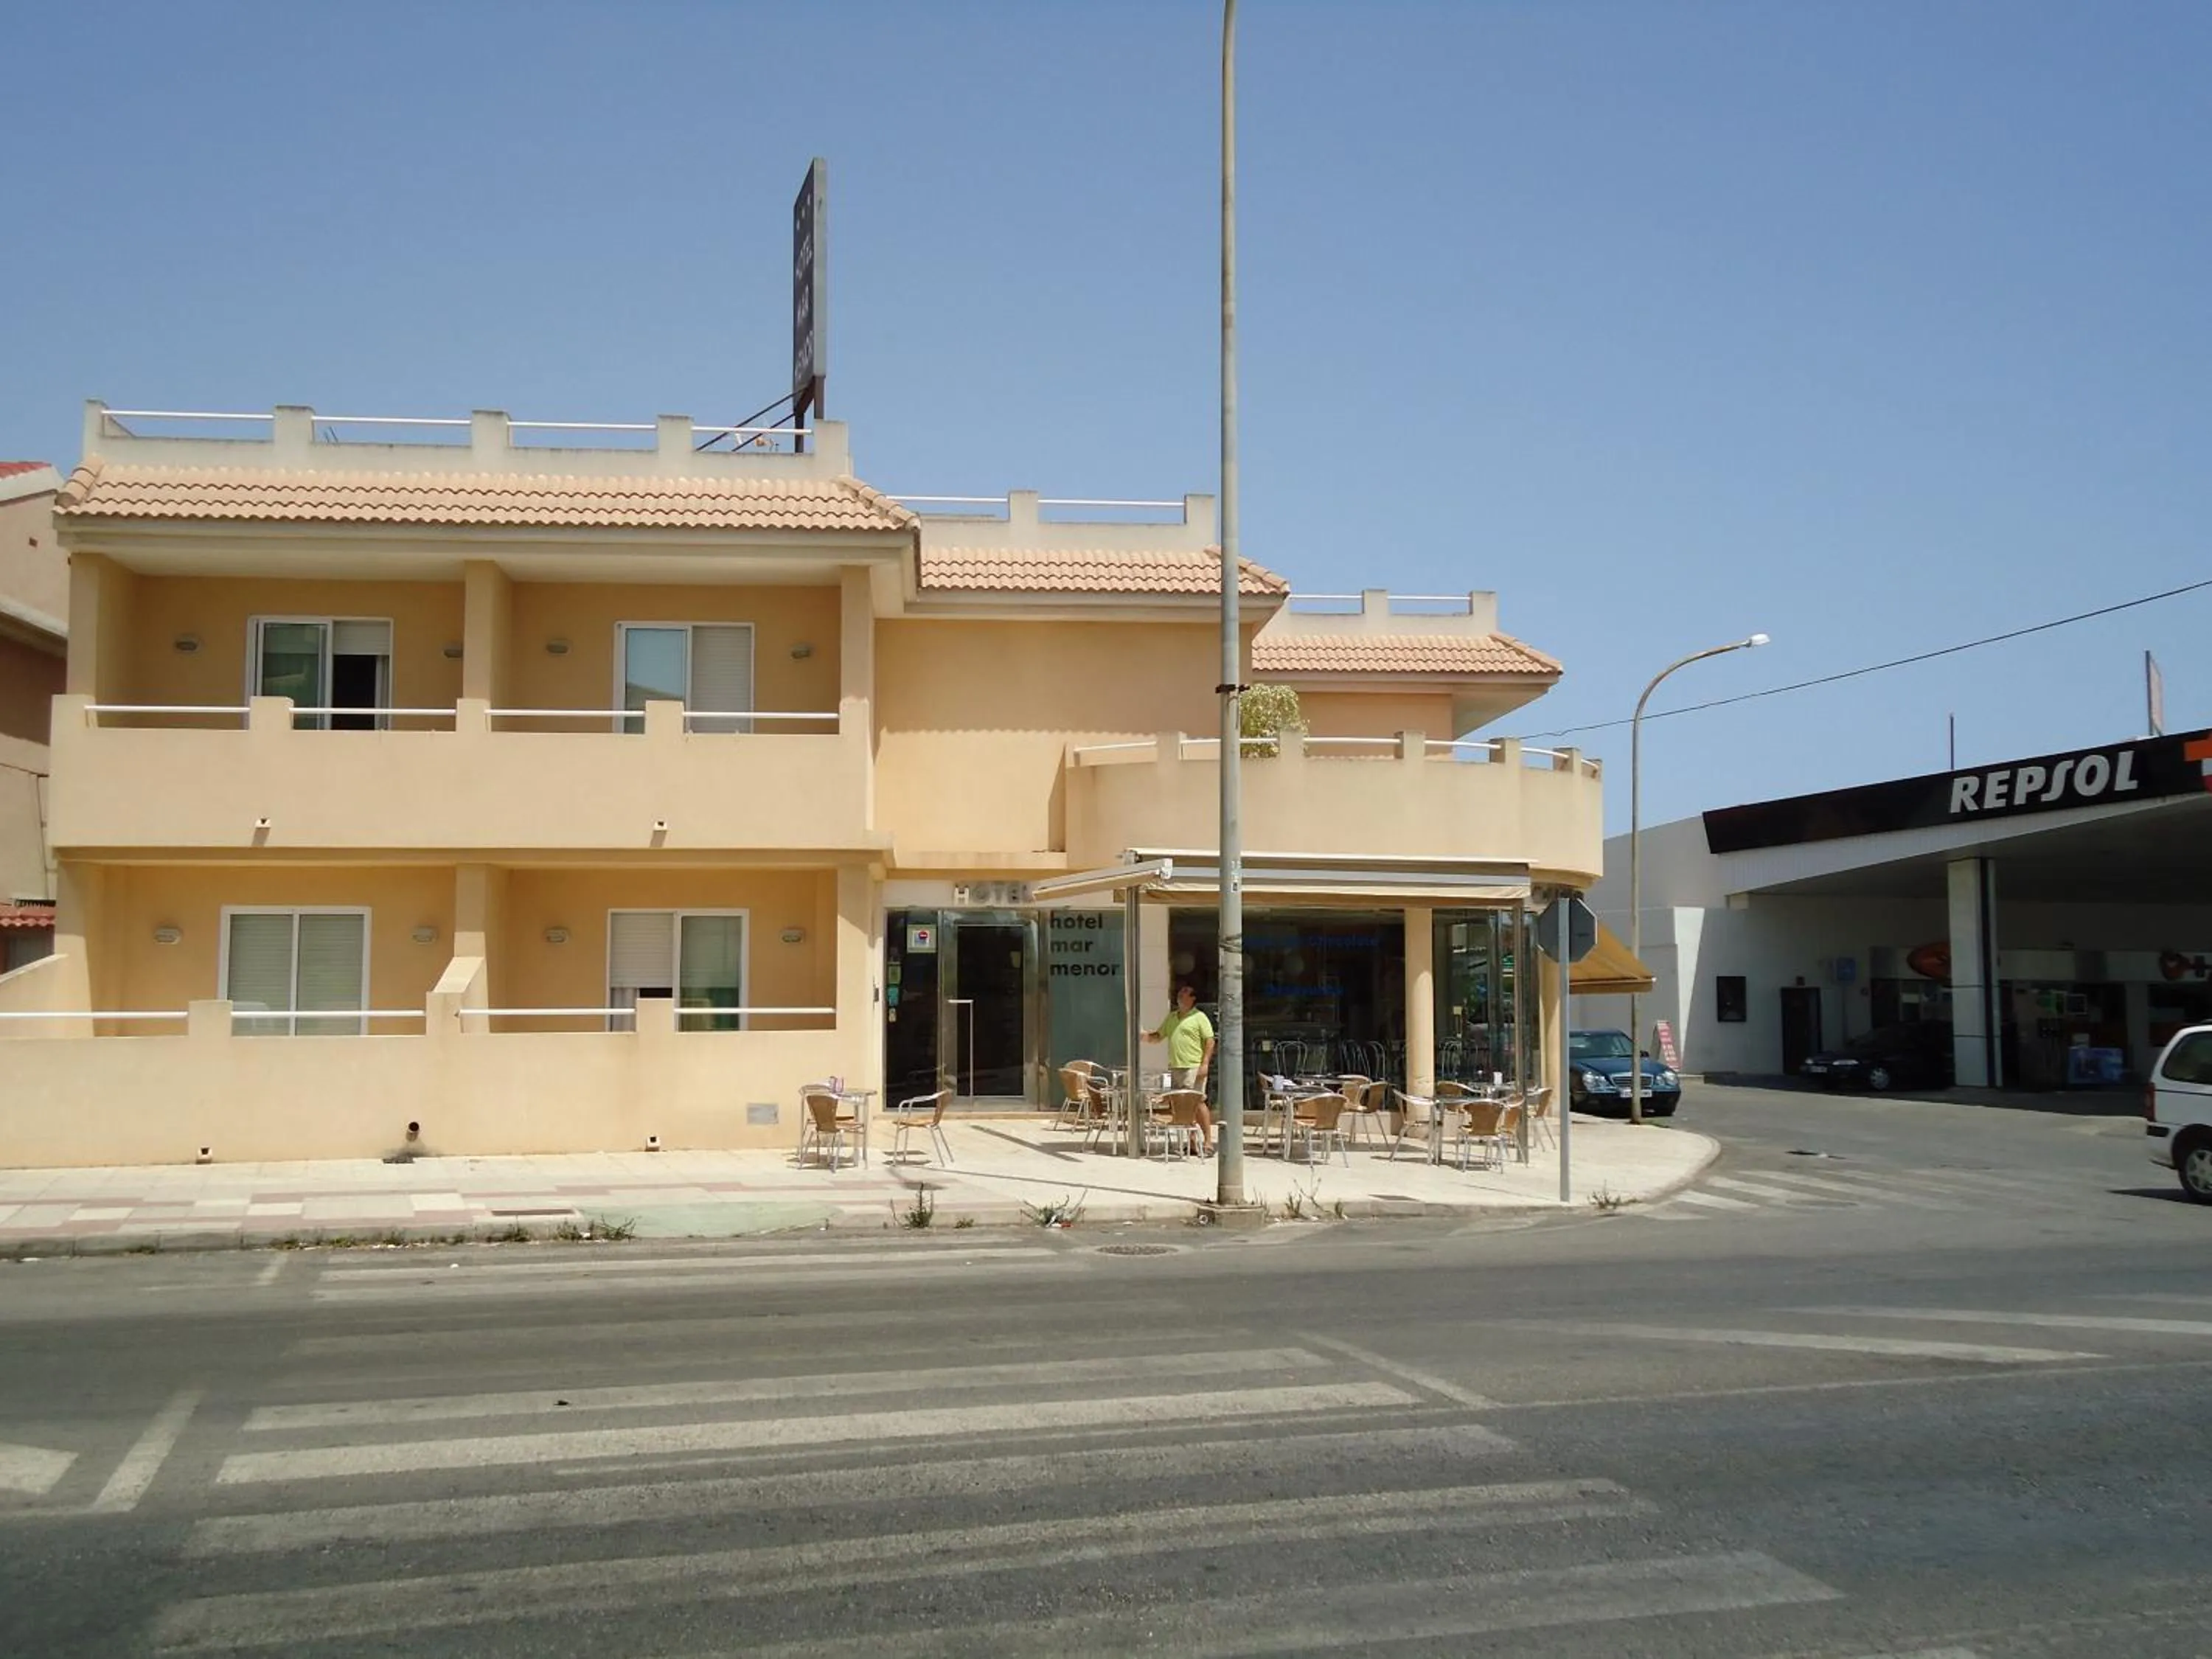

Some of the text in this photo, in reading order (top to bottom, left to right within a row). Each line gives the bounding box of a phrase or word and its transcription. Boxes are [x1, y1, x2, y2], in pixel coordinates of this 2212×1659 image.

[1950, 750, 2138, 813] REPSOL
[1050, 911, 1102, 929] hotel
[1050, 941, 1093, 953] mar
[1050, 964, 1120, 976] menor
